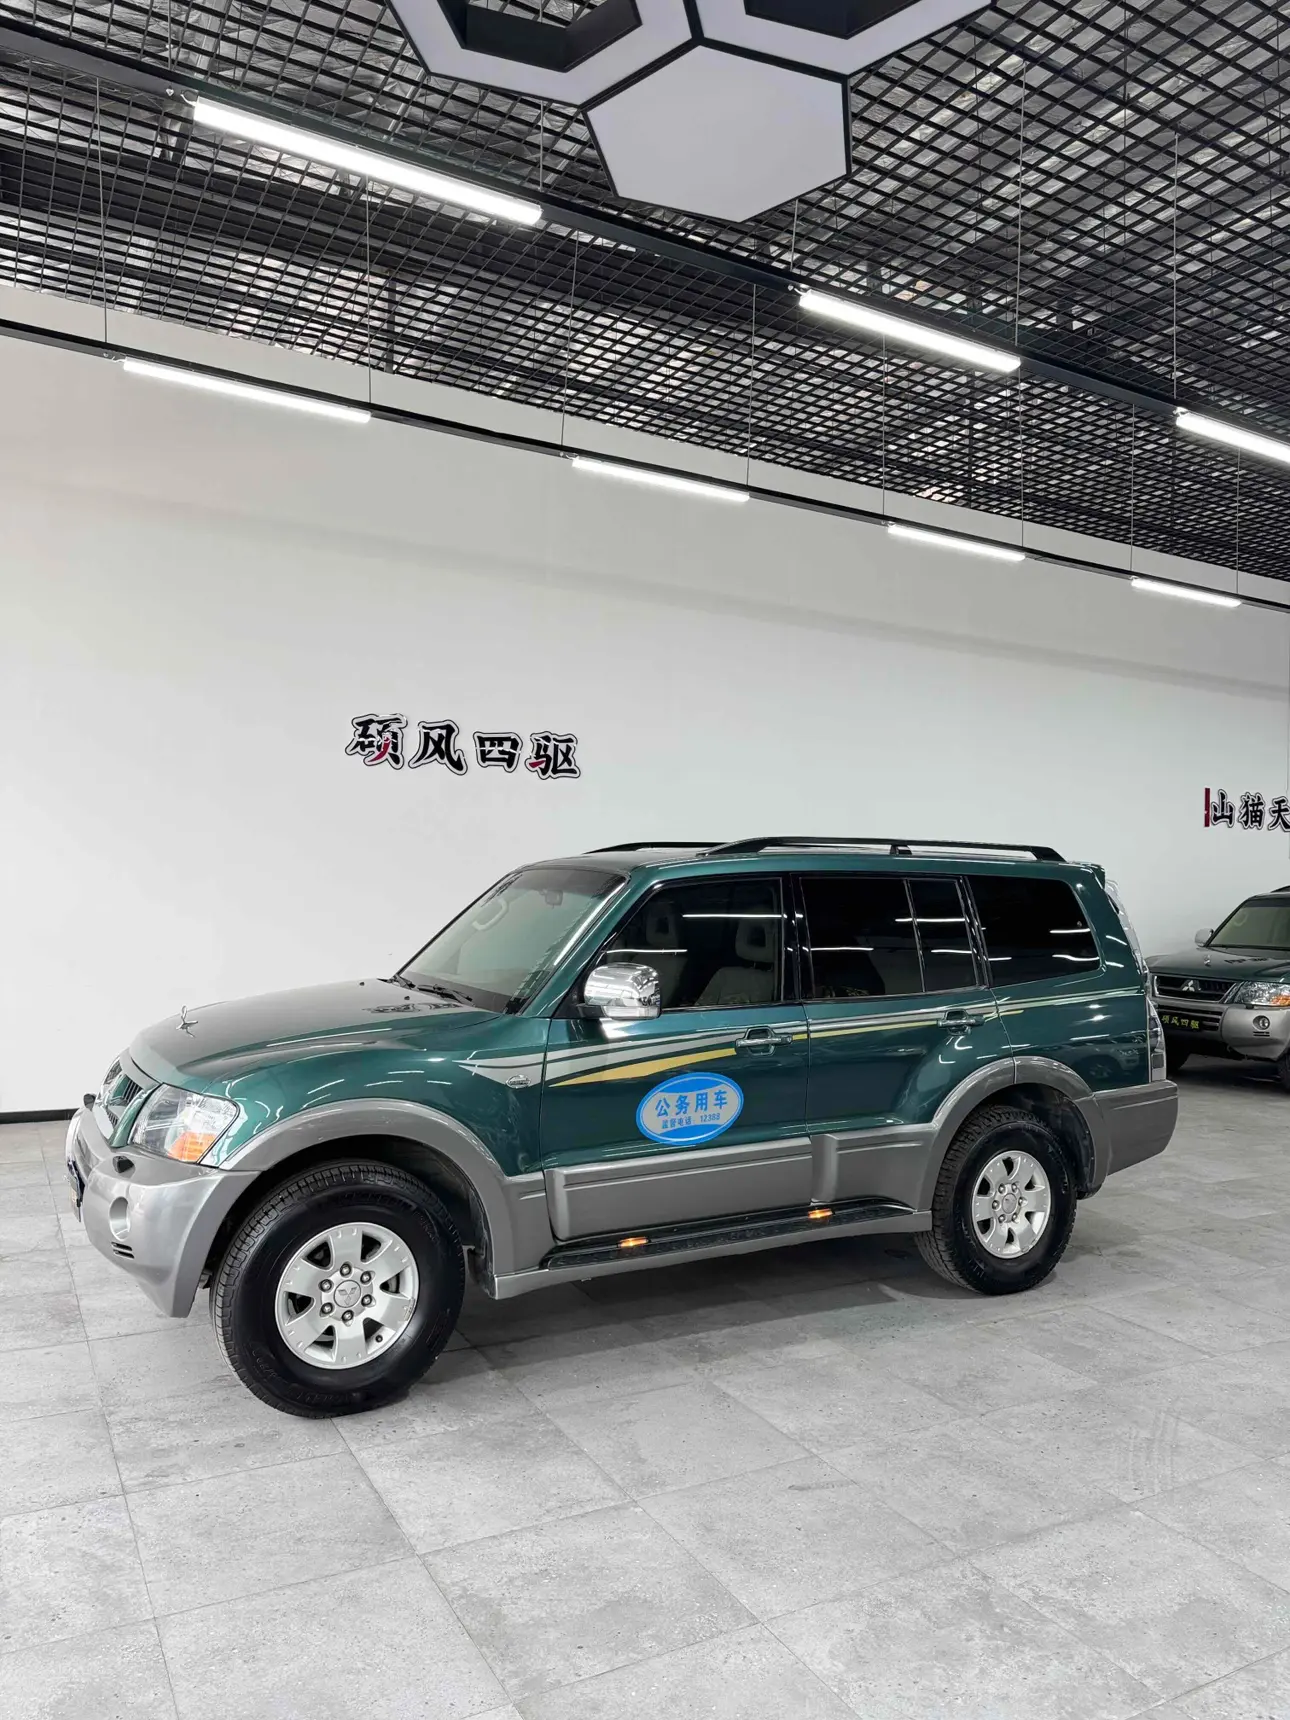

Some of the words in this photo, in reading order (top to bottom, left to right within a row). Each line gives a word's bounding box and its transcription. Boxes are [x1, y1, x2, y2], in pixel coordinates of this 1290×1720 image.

[346, 713, 581, 780] 硕风四驱
[655, 1090, 728, 1117] 公务用车
